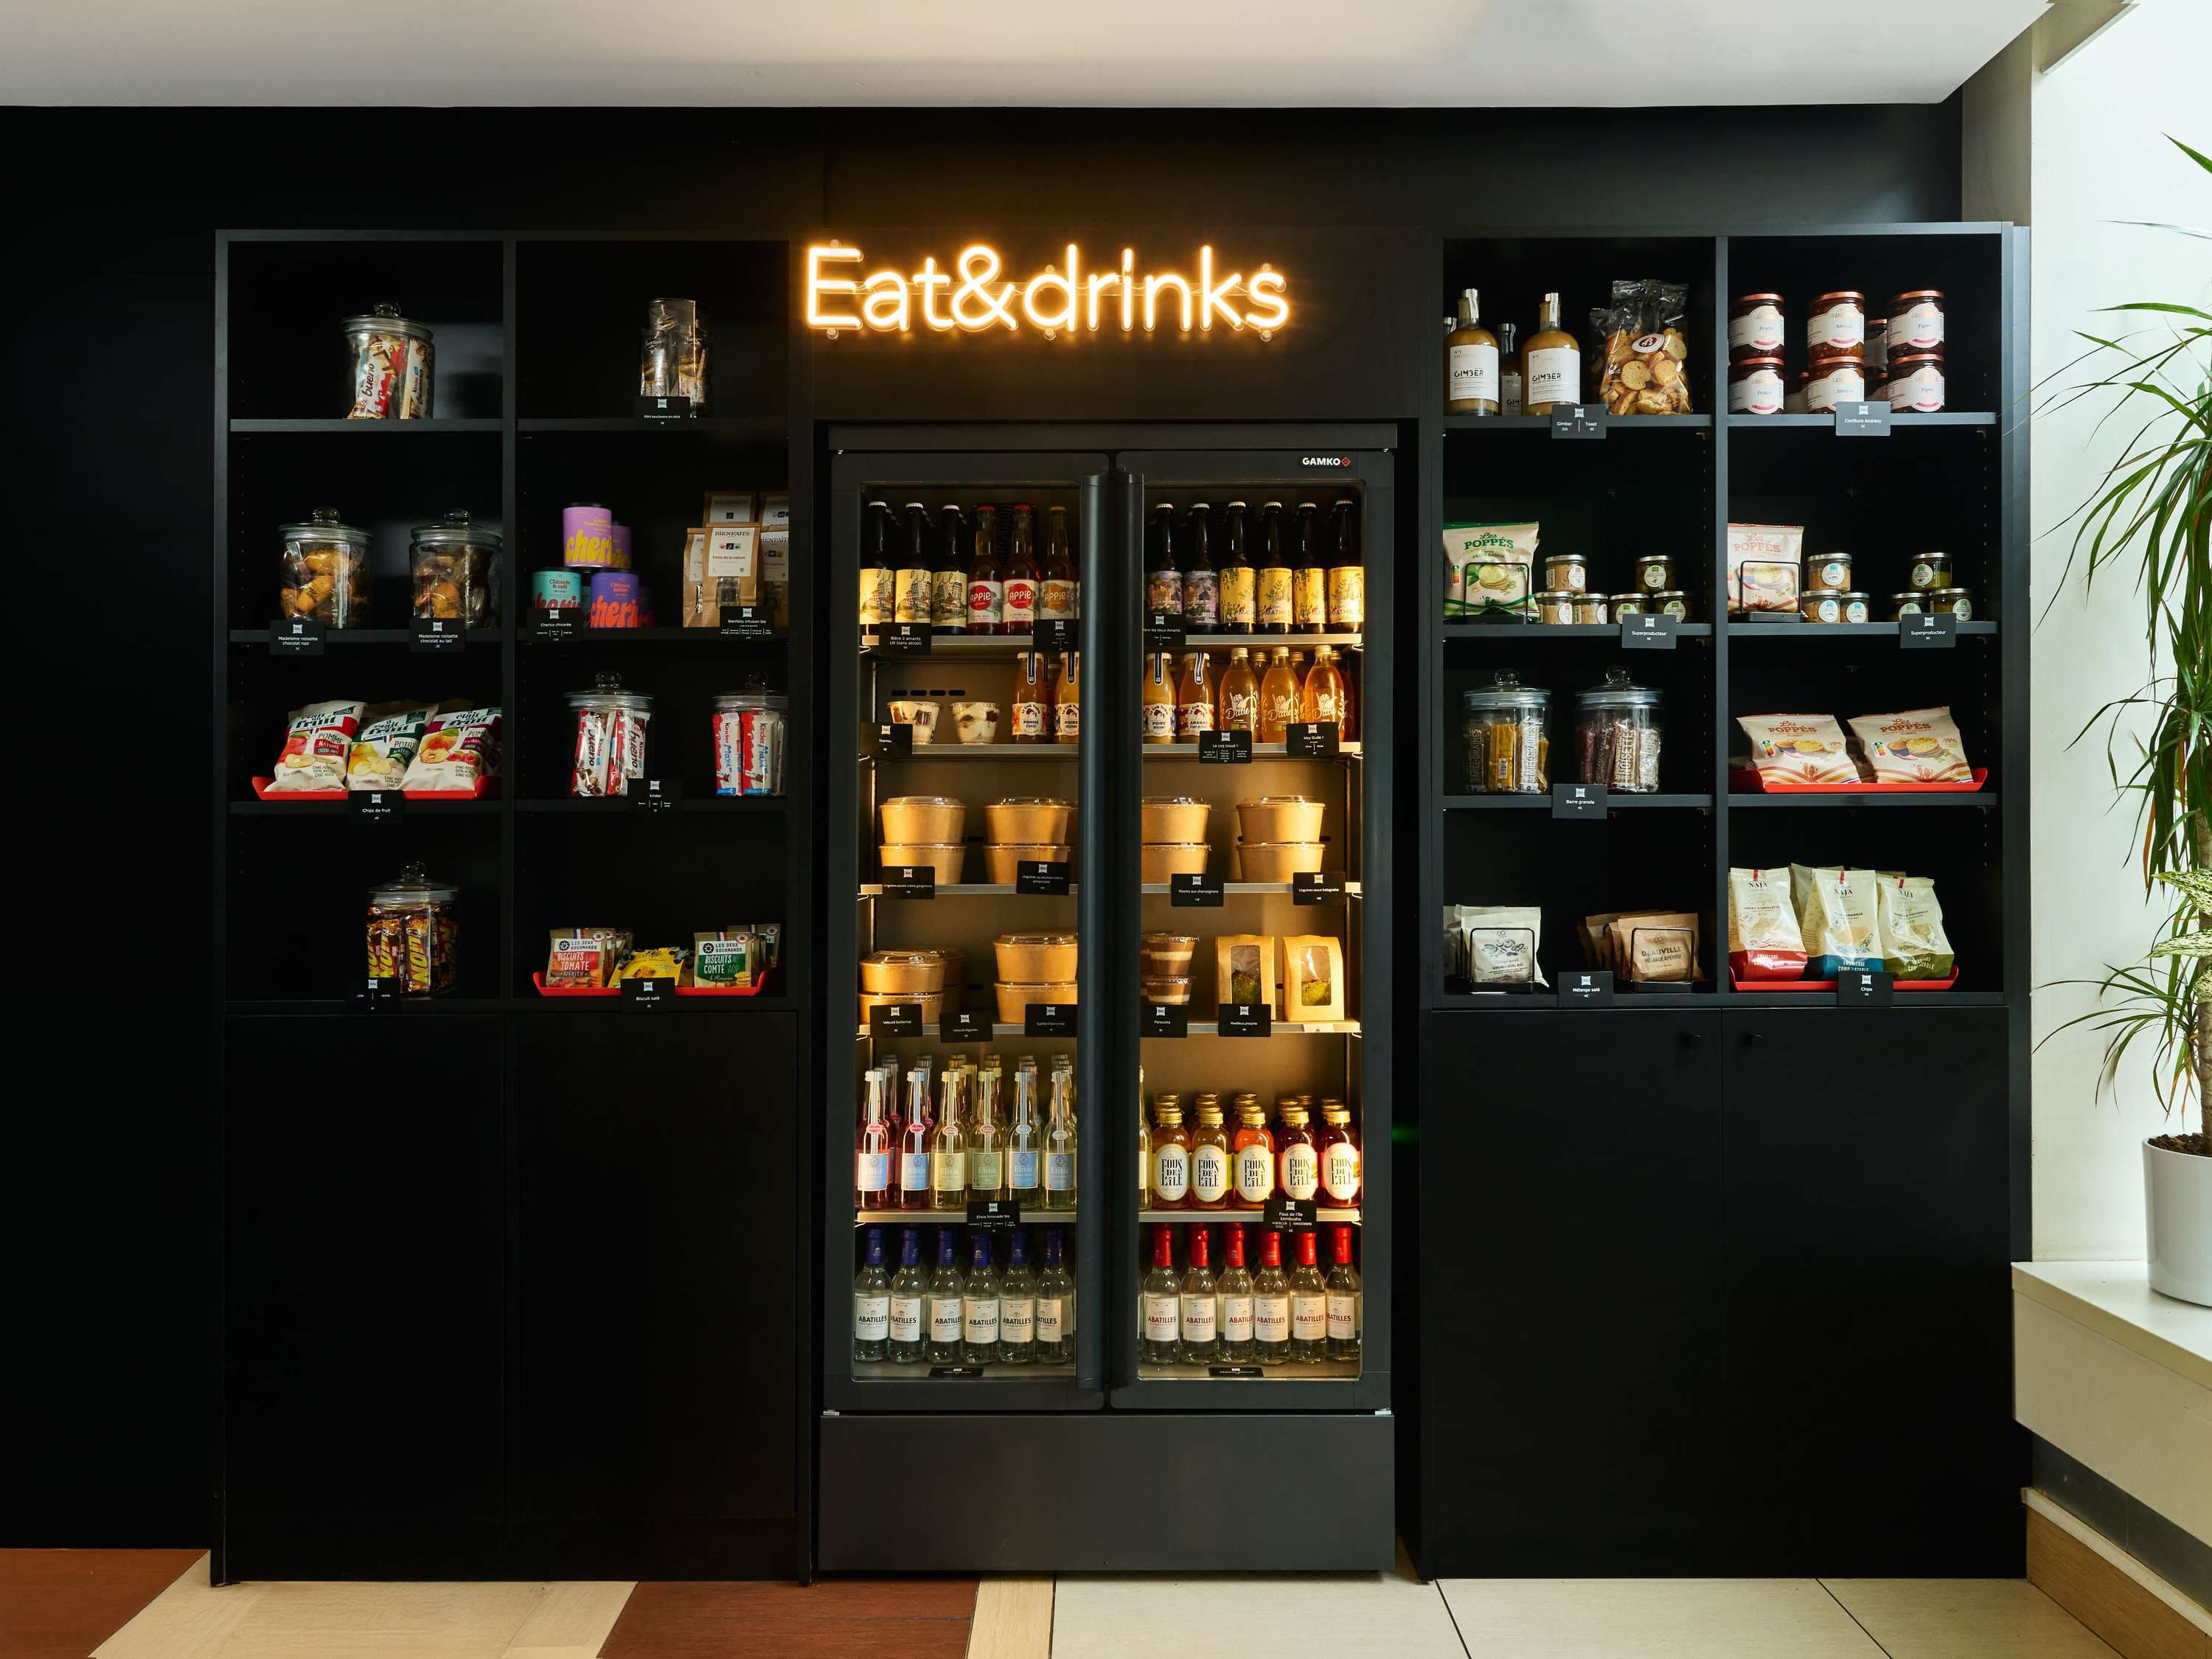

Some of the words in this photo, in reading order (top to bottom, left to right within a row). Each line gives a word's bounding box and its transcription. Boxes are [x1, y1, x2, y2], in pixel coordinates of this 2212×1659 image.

[807, 244, 1290, 331] Eat&drinks
[1302, 457, 1341, 466] GAMKO
[1480, 532, 1498, 540] Les
[1464, 537, 1514, 550] POPPÉS
[1879, 722, 1931, 733] POPPÉS
[408, 936, 431, 985] LION
[557, 952, 585, 961] BISCUITS
[705, 955, 732, 964] BISCUITS
[560, 961, 590, 971] TOMATE
[858, 1315, 887, 1324] ABATILLES
[934, 1315, 962, 1325] ABATILLES
[969, 1316, 997, 1326] ABATILLES
[1003, 1317, 1031, 1325] ABATILLES
[1147, 1315, 1176, 1324] ABATILLES
[1186, 1316, 1214, 1325] ABATILLES
[1256, 1315, 1285, 1325] ABATILLES
[1295, 1314, 1324, 1324] ABATILLES
